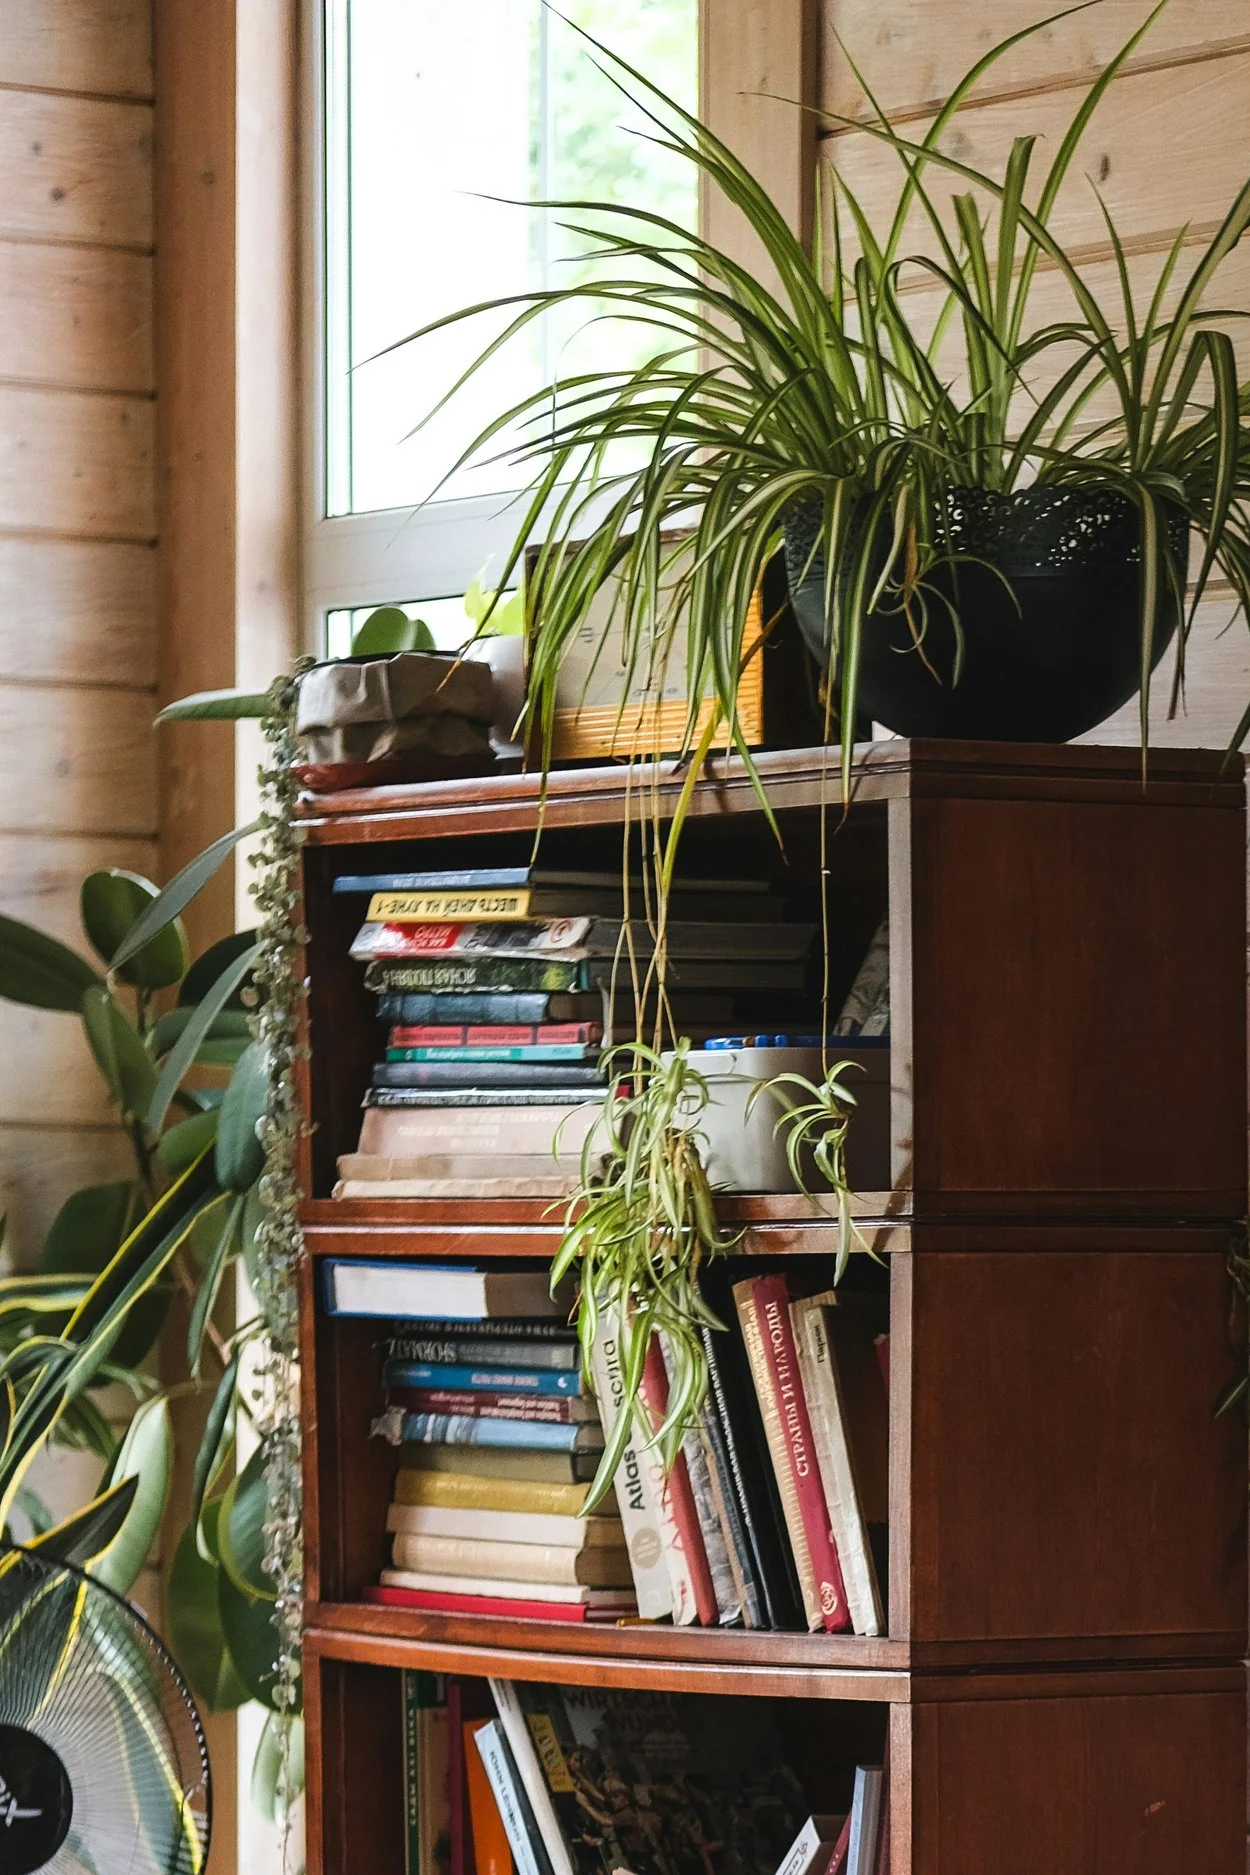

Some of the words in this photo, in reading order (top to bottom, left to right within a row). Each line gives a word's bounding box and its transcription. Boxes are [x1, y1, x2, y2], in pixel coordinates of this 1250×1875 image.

[425, 900, 441, 913] НА
[444, 898, 477, 917] ДНЕЙ
[480, 898, 519, 912] ШЕСТЬ
[764, 1300, 792, 1380] НАРОДЫ
[780, 1383, 793, 1400] И
[784, 1402, 809, 1478] СТРАНЫ
[624, 1450, 646, 1511] Atlas
